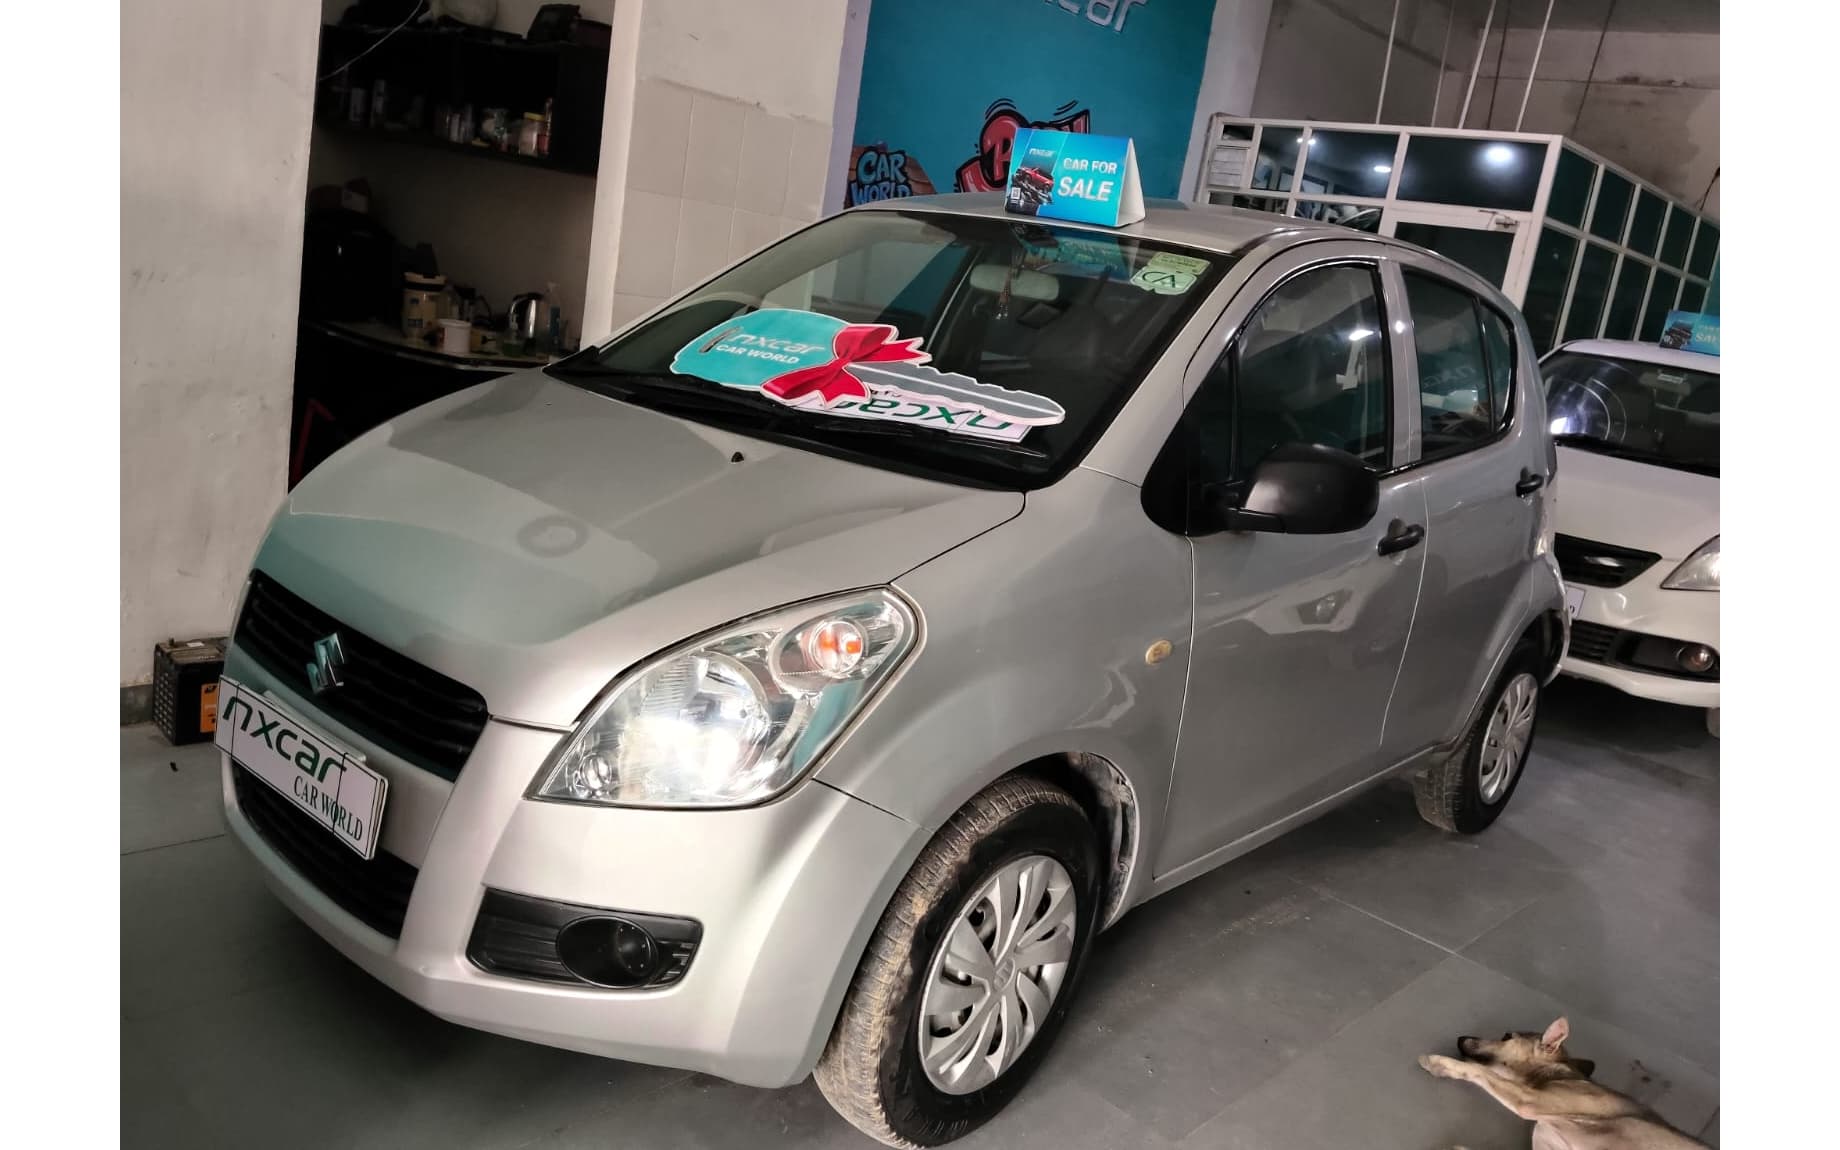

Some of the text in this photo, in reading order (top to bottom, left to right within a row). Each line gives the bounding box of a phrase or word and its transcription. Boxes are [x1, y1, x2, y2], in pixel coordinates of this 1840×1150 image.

[857, 150, 907, 186] CAR
[1063, 157, 1118, 175] CAR FOR
[1058, 176, 1115, 202] SALE
[716, 344, 800, 364] CAR WORLD
[730, 333, 825, 354] nxcar
[222, 695, 348, 783] nxcar
[293, 775, 363, 841] CAR WORLD
